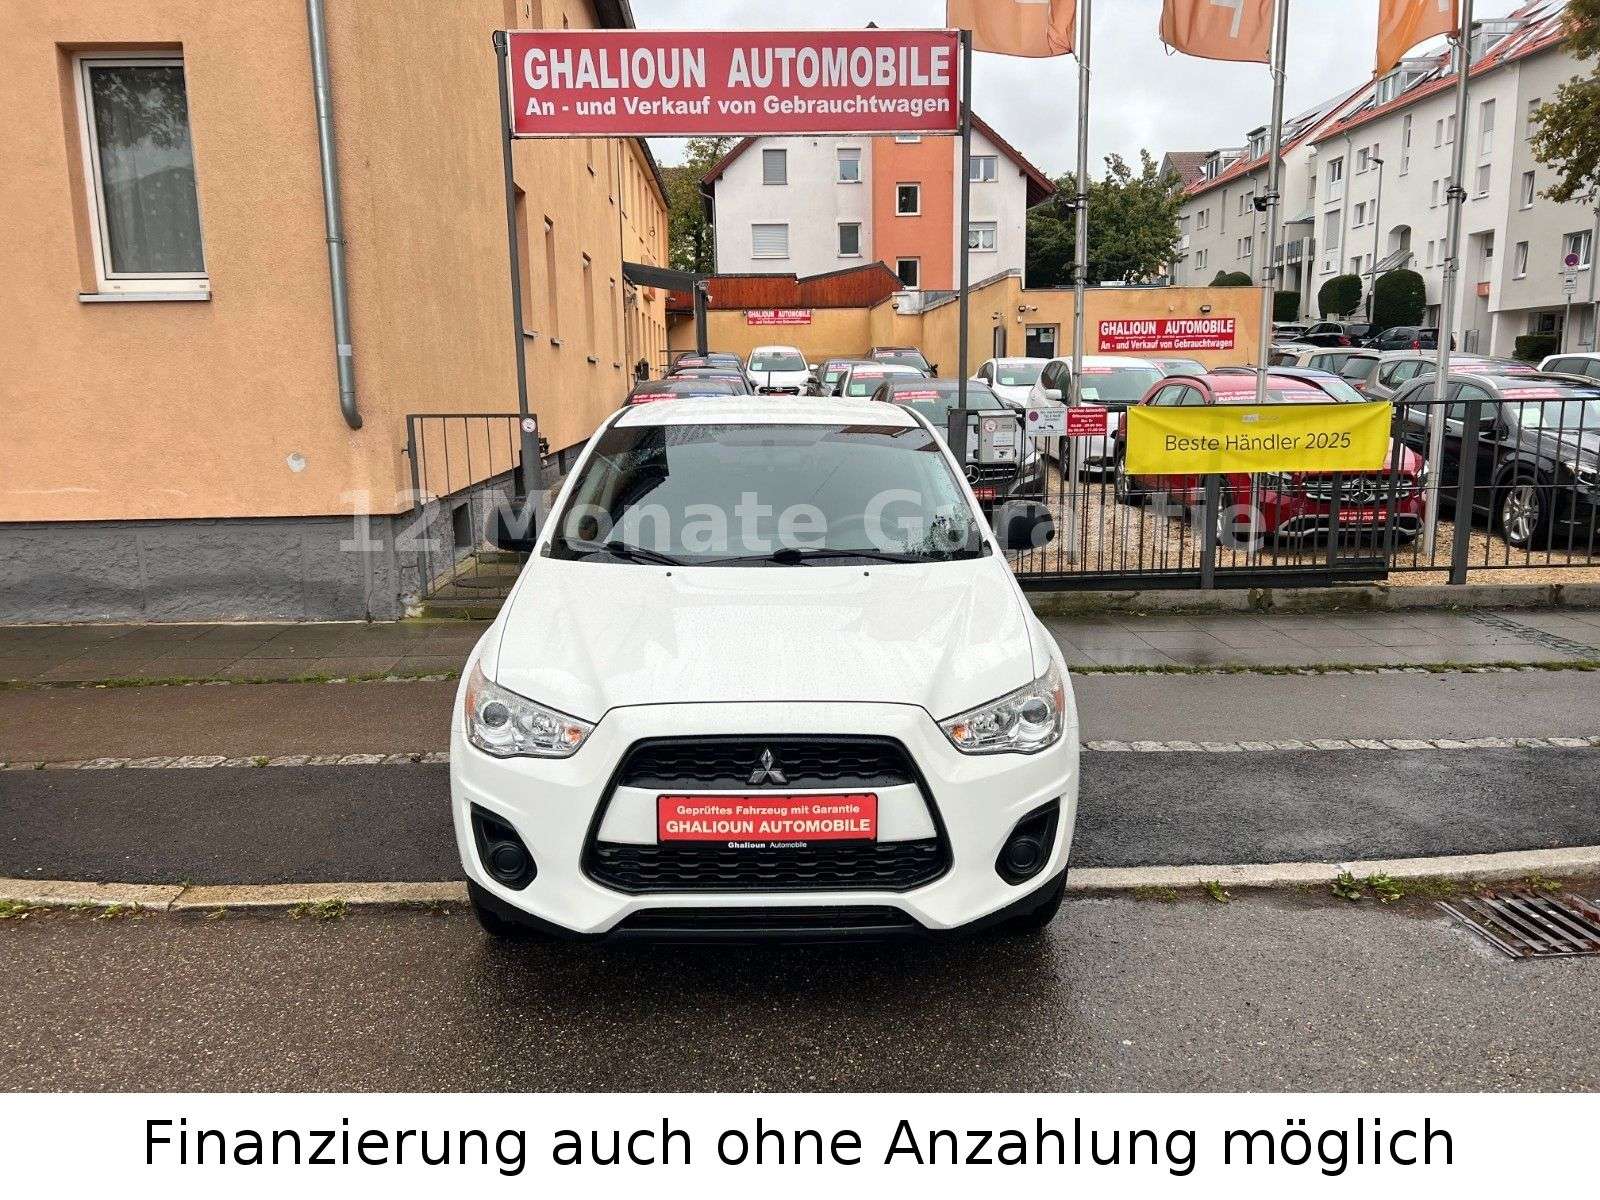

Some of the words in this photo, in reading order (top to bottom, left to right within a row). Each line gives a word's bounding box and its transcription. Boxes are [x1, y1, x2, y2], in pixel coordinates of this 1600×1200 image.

[523, 46, 706, 90] GHALIOUN
[727, 45, 950, 89] AUTOMOBILE
[525, 96, 555, 116] An
[575, 96, 616, 116] und
[623, 96, 711, 116] Verkauf
[718, 99, 756, 115] von
[763, 95, 950, 118] Gebrauchtwagen
[1101, 321, 1157, 336] GHALIOUN
[1164, 319, 1234, 335] AUTOMOBILE
[1101, 340, 1111, 350] An
[1116, 340, 1130, 350] und
[1131, 340, 1159, 349] Verkauf
[1160, 340, 1173, 349] von
[1174, 338, 1233, 350] Gebrauchtwagen
[1165, 434, 1220, 452] Beste
[1226, 433, 1301, 451] Händler
[1305, 432, 1351, 450] 2025
[677, 805, 733, 816] Geprüftes
[736, 805, 787, 816] Fahrzeug
[791, 805, 809, 815] mit
[812, 804, 860, 815] Garantie
[666, 820, 753, 834] GHALIOUN
[759, 819, 871, 834] AUTOMOBILE
[728, 841, 766, 849] Ghalioun
[770, 841, 807, 849] Automobile
